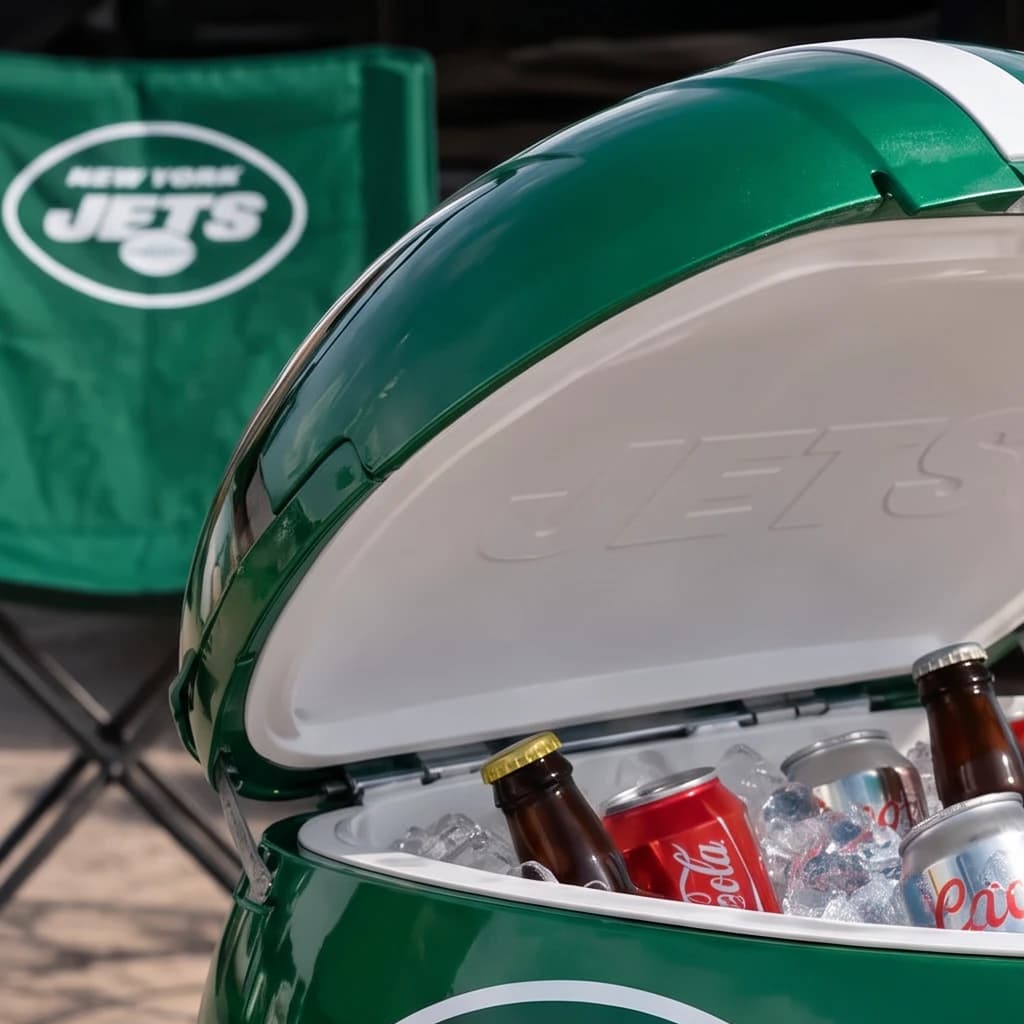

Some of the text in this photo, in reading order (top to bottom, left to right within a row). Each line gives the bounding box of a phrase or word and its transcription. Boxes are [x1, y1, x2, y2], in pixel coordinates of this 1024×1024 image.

[65, 165, 244, 189] NEW YORK
[43, 191, 267, 243] JETS
